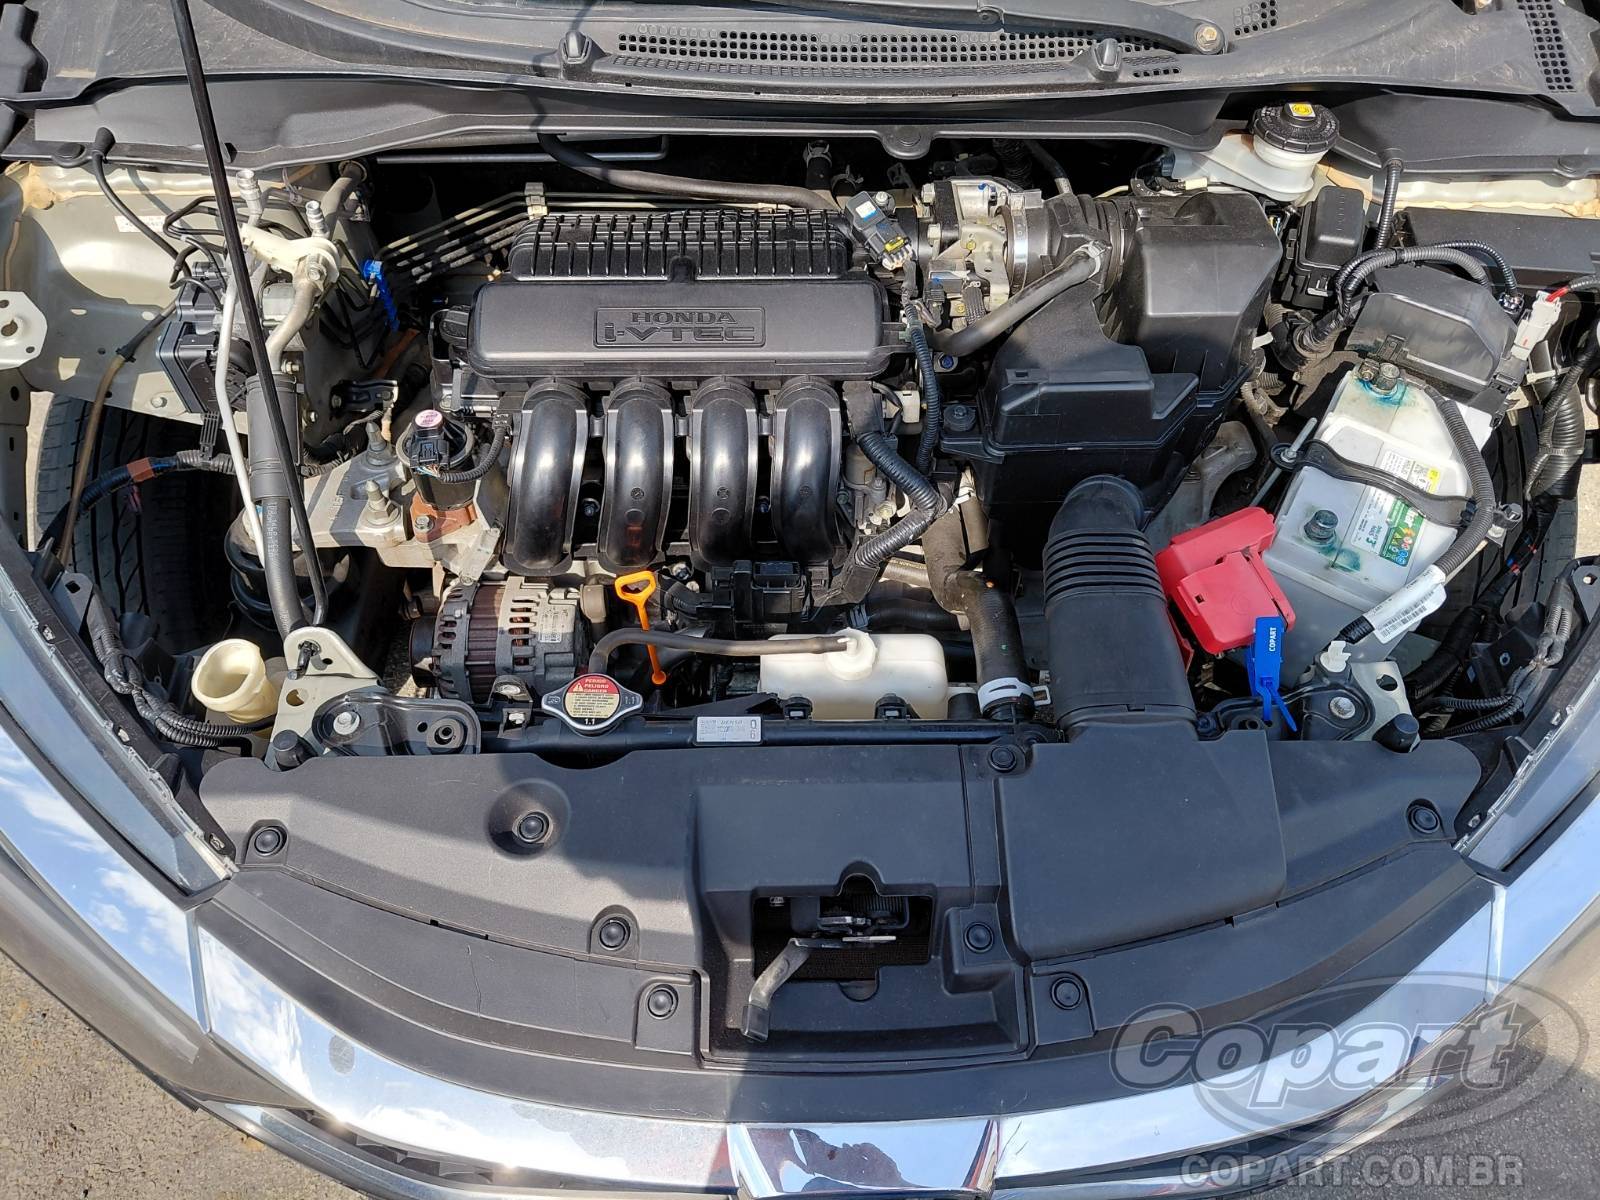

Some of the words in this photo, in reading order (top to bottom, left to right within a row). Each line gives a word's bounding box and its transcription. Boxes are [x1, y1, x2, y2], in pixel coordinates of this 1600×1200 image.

[631, 311, 736, 325] HONDA
[604, 322, 755, 342] i-VTEC
[1268, 627, 1277, 652] COPART
[625, 697, 635, 705] 1.1
